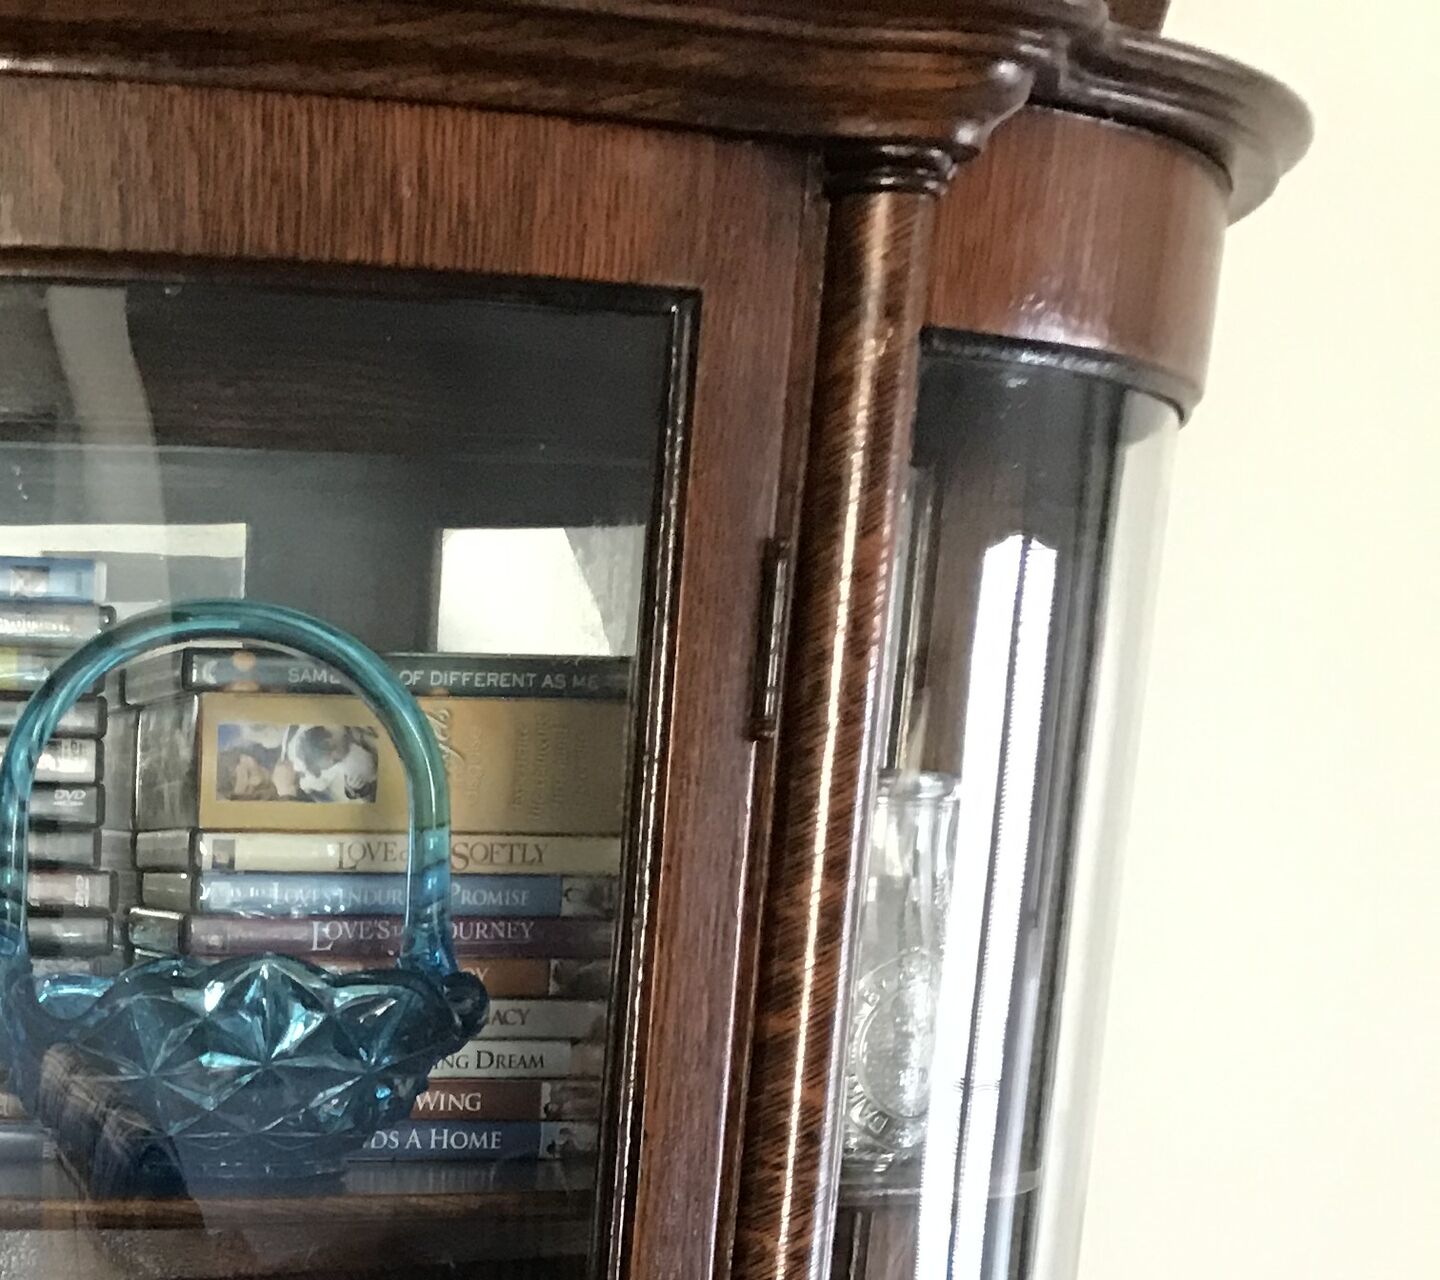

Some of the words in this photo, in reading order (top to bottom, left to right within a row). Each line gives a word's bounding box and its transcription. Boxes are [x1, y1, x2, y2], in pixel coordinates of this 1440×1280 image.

[398, 669, 426, 686] OF
[429, 669, 535, 689] DIFFERENT
[540, 672, 567, 689] AS
[336, 841, 397, 870] LOVE
[452, 841, 549, 870] SOFTLY
[451, 884, 529, 907] PROMISE
[310, 920, 391, 951] LOVE'S
[488, 1009, 531, 1026] ACY
[475, 1050, 545, 1070] DREAM
[415, 1090, 482, 1111] WING
[364, 1130, 400, 1150] DS
[404, 1128, 422, 1150] A
[429, 1128, 503, 1150] HOME
